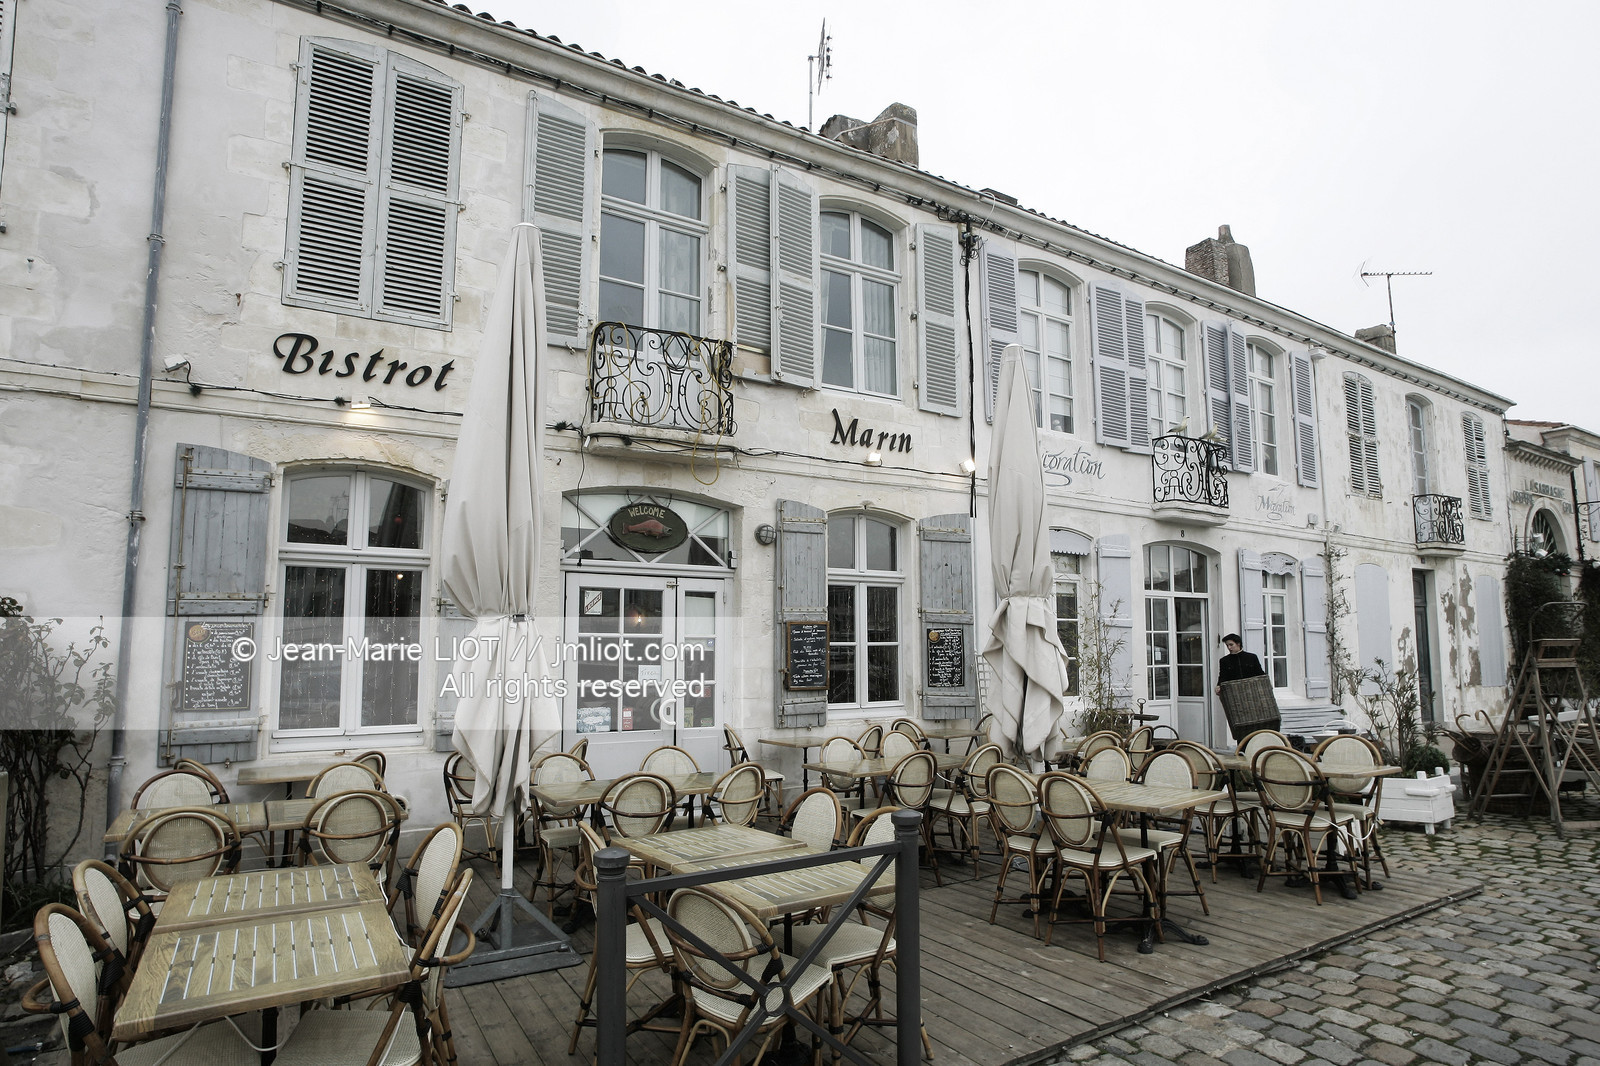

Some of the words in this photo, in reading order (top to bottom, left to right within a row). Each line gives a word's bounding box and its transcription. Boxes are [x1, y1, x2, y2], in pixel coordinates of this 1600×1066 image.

[273, 332, 456, 392] Bistrot
[830, 408, 912, 454] Marin
[1042, 446, 1106, 486] igration
[628, 505, 666, 519] WELCOME
[1180, 529, 1185, 538] 8
